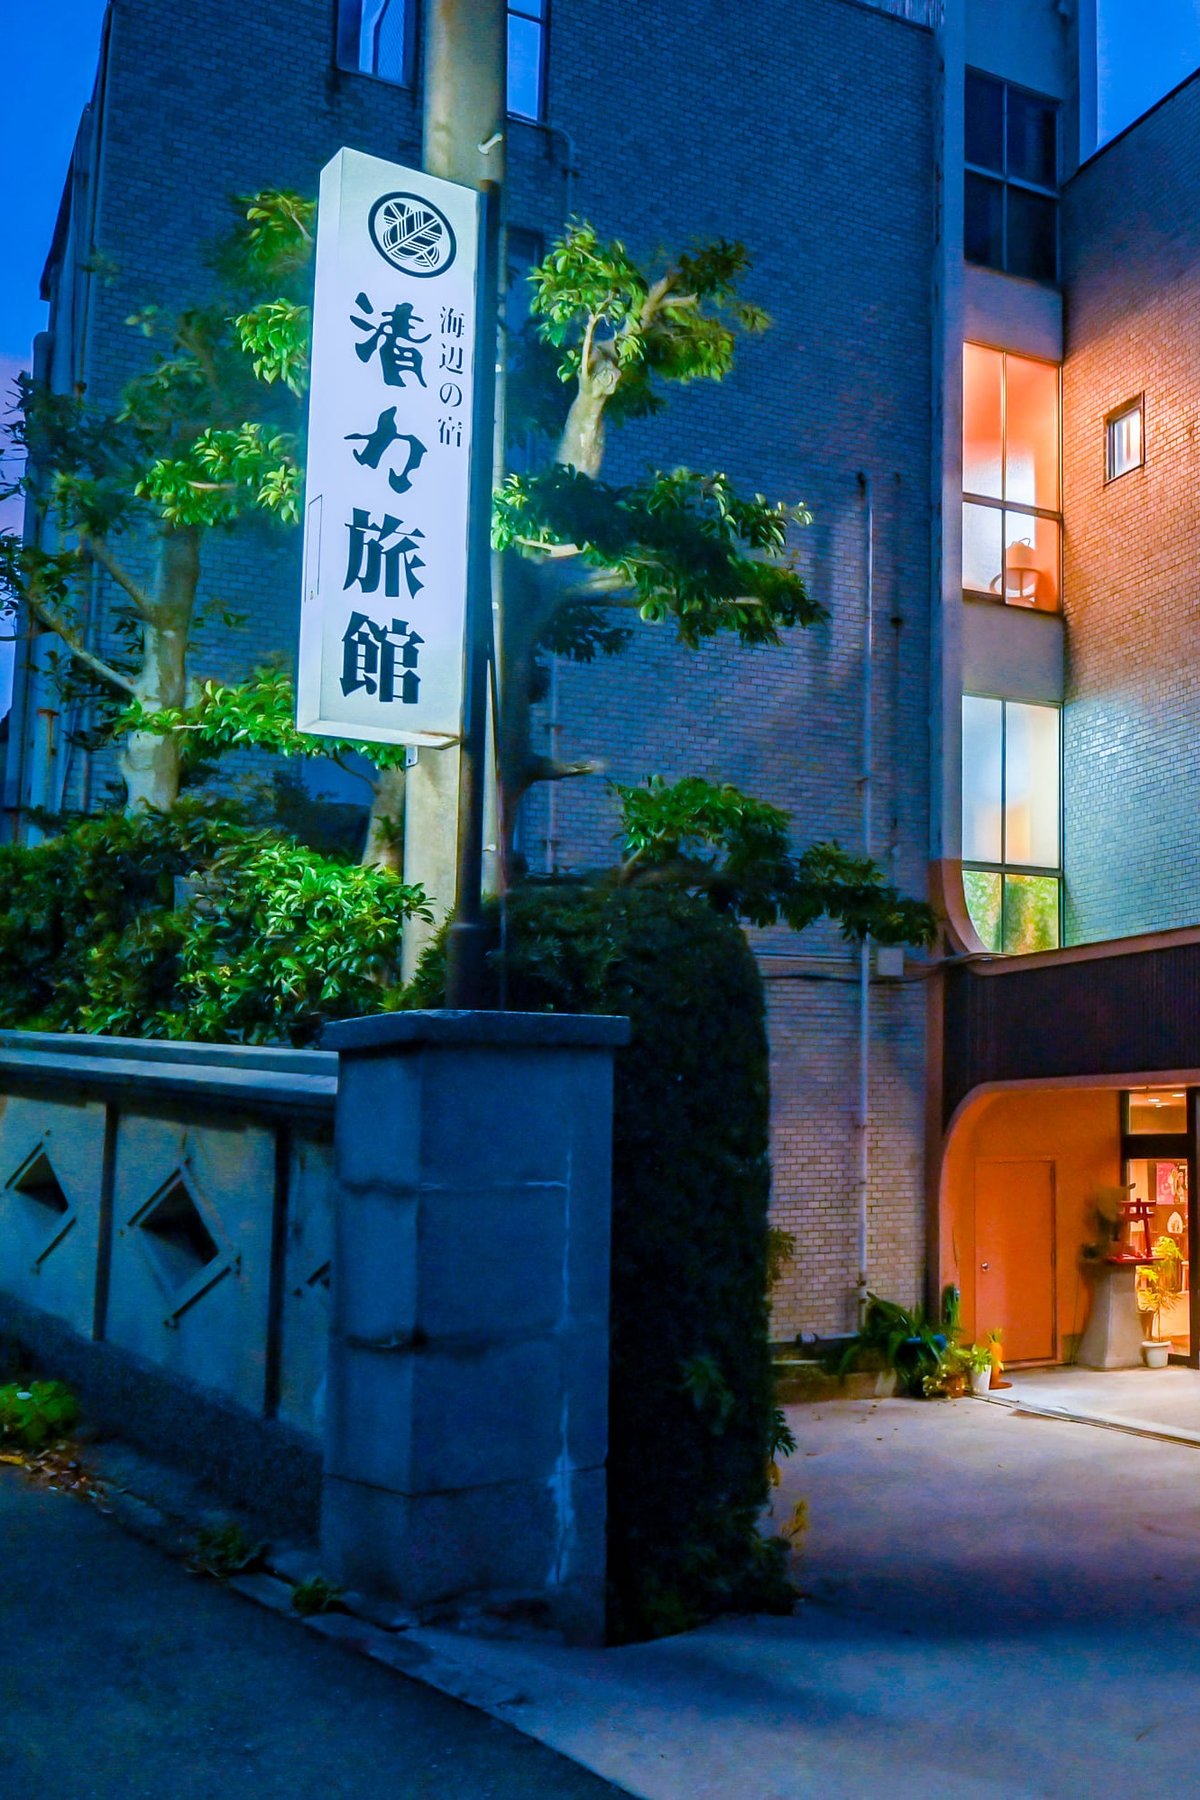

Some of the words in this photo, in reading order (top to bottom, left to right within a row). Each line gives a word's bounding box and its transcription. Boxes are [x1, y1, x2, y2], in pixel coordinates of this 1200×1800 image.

[340, 291, 432, 704] 清力旅館
[438, 305, 465, 448] 海辺の宿
